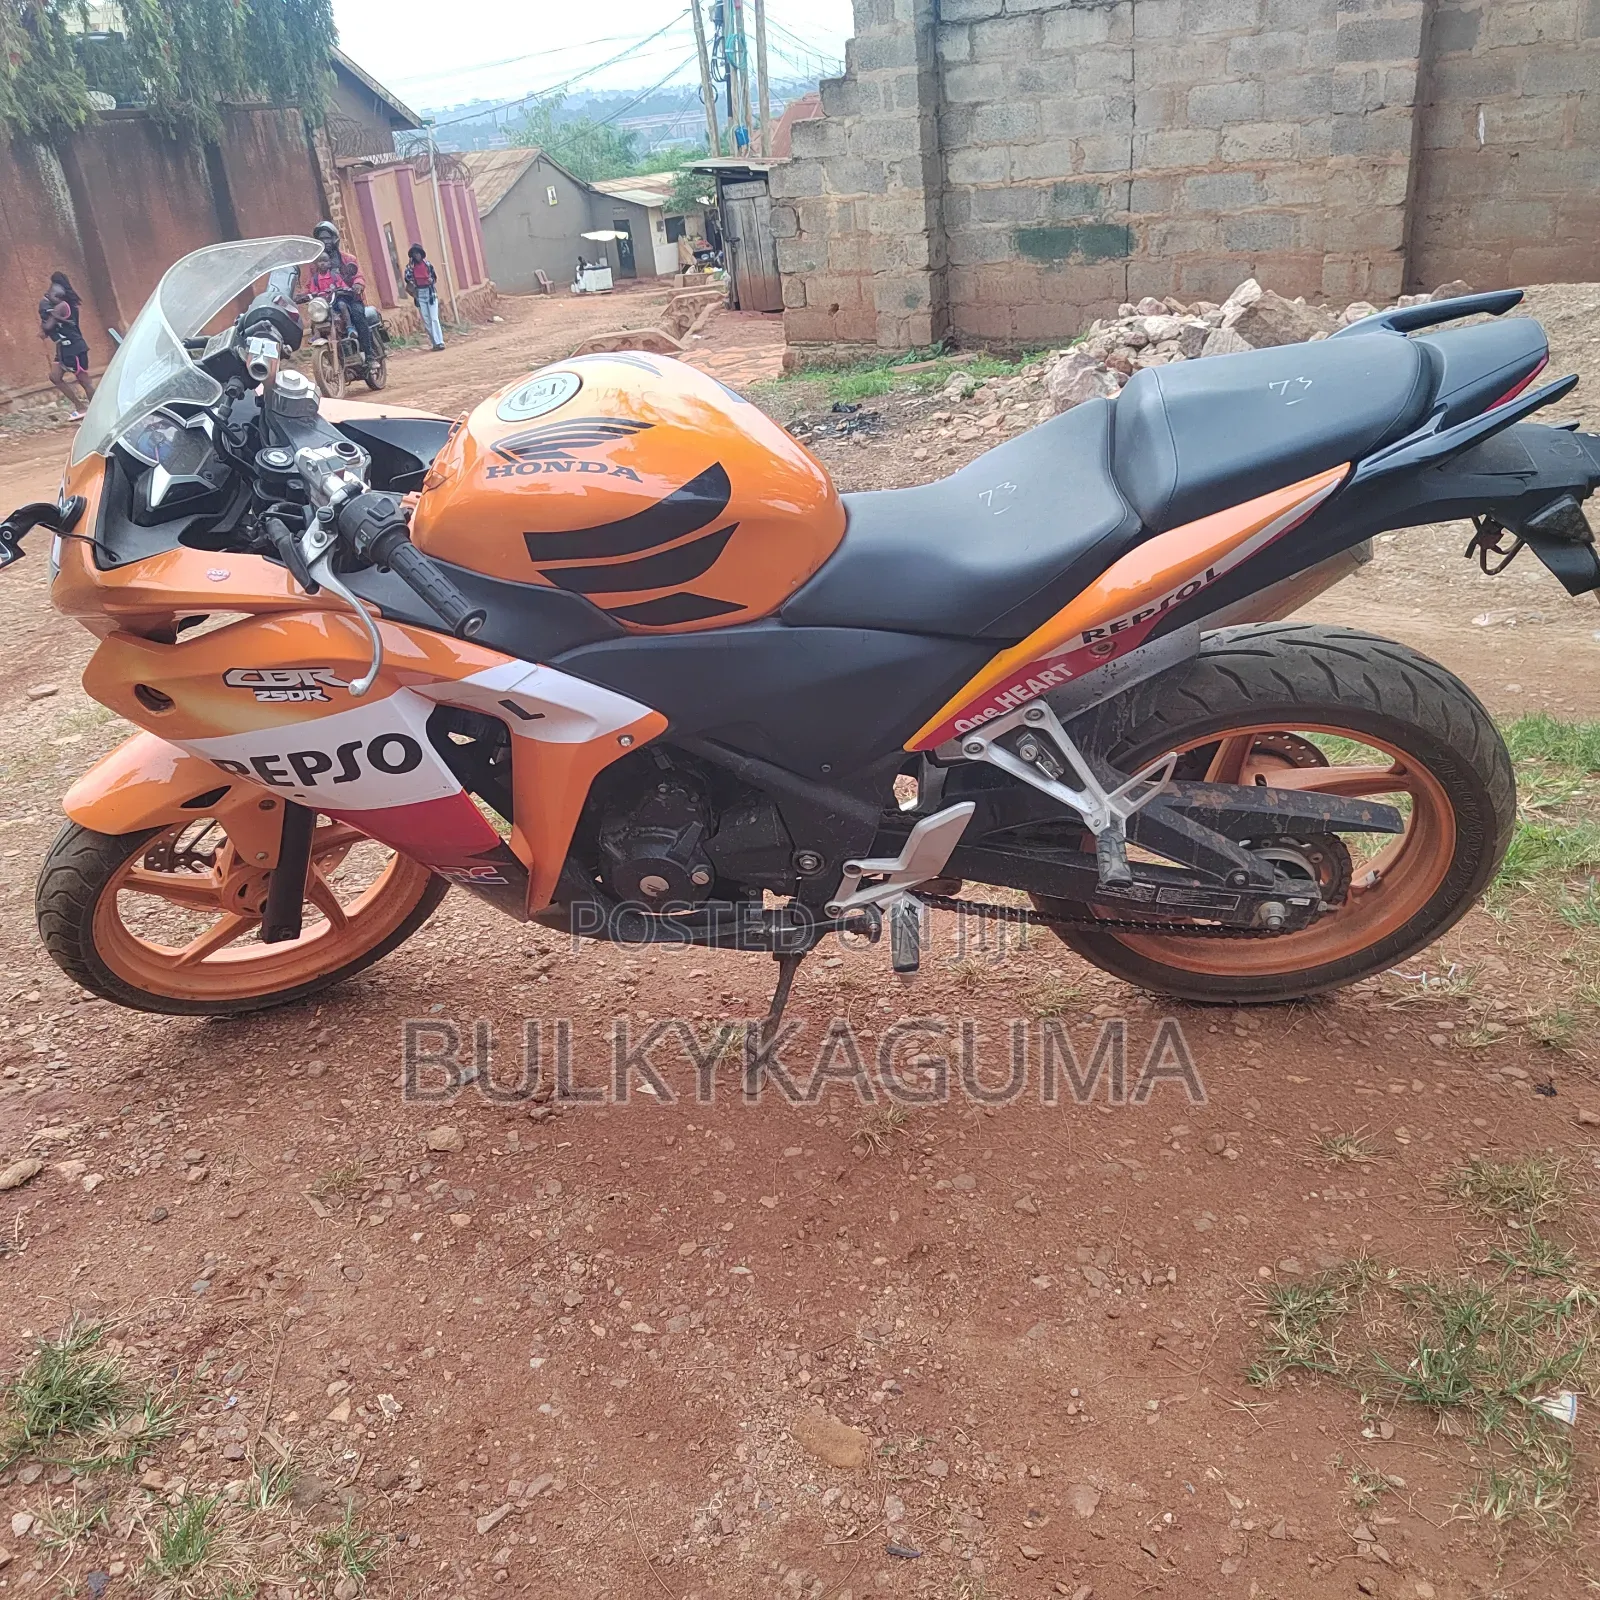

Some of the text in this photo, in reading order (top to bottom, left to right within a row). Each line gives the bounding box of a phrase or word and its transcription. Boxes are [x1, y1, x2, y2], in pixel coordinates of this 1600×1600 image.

[485, 460, 644, 484] HONDA
[1081, 566, 1222, 645] REPSOL
[221, 667, 351, 689] CBR
[954, 662, 1074, 733] One HEART
